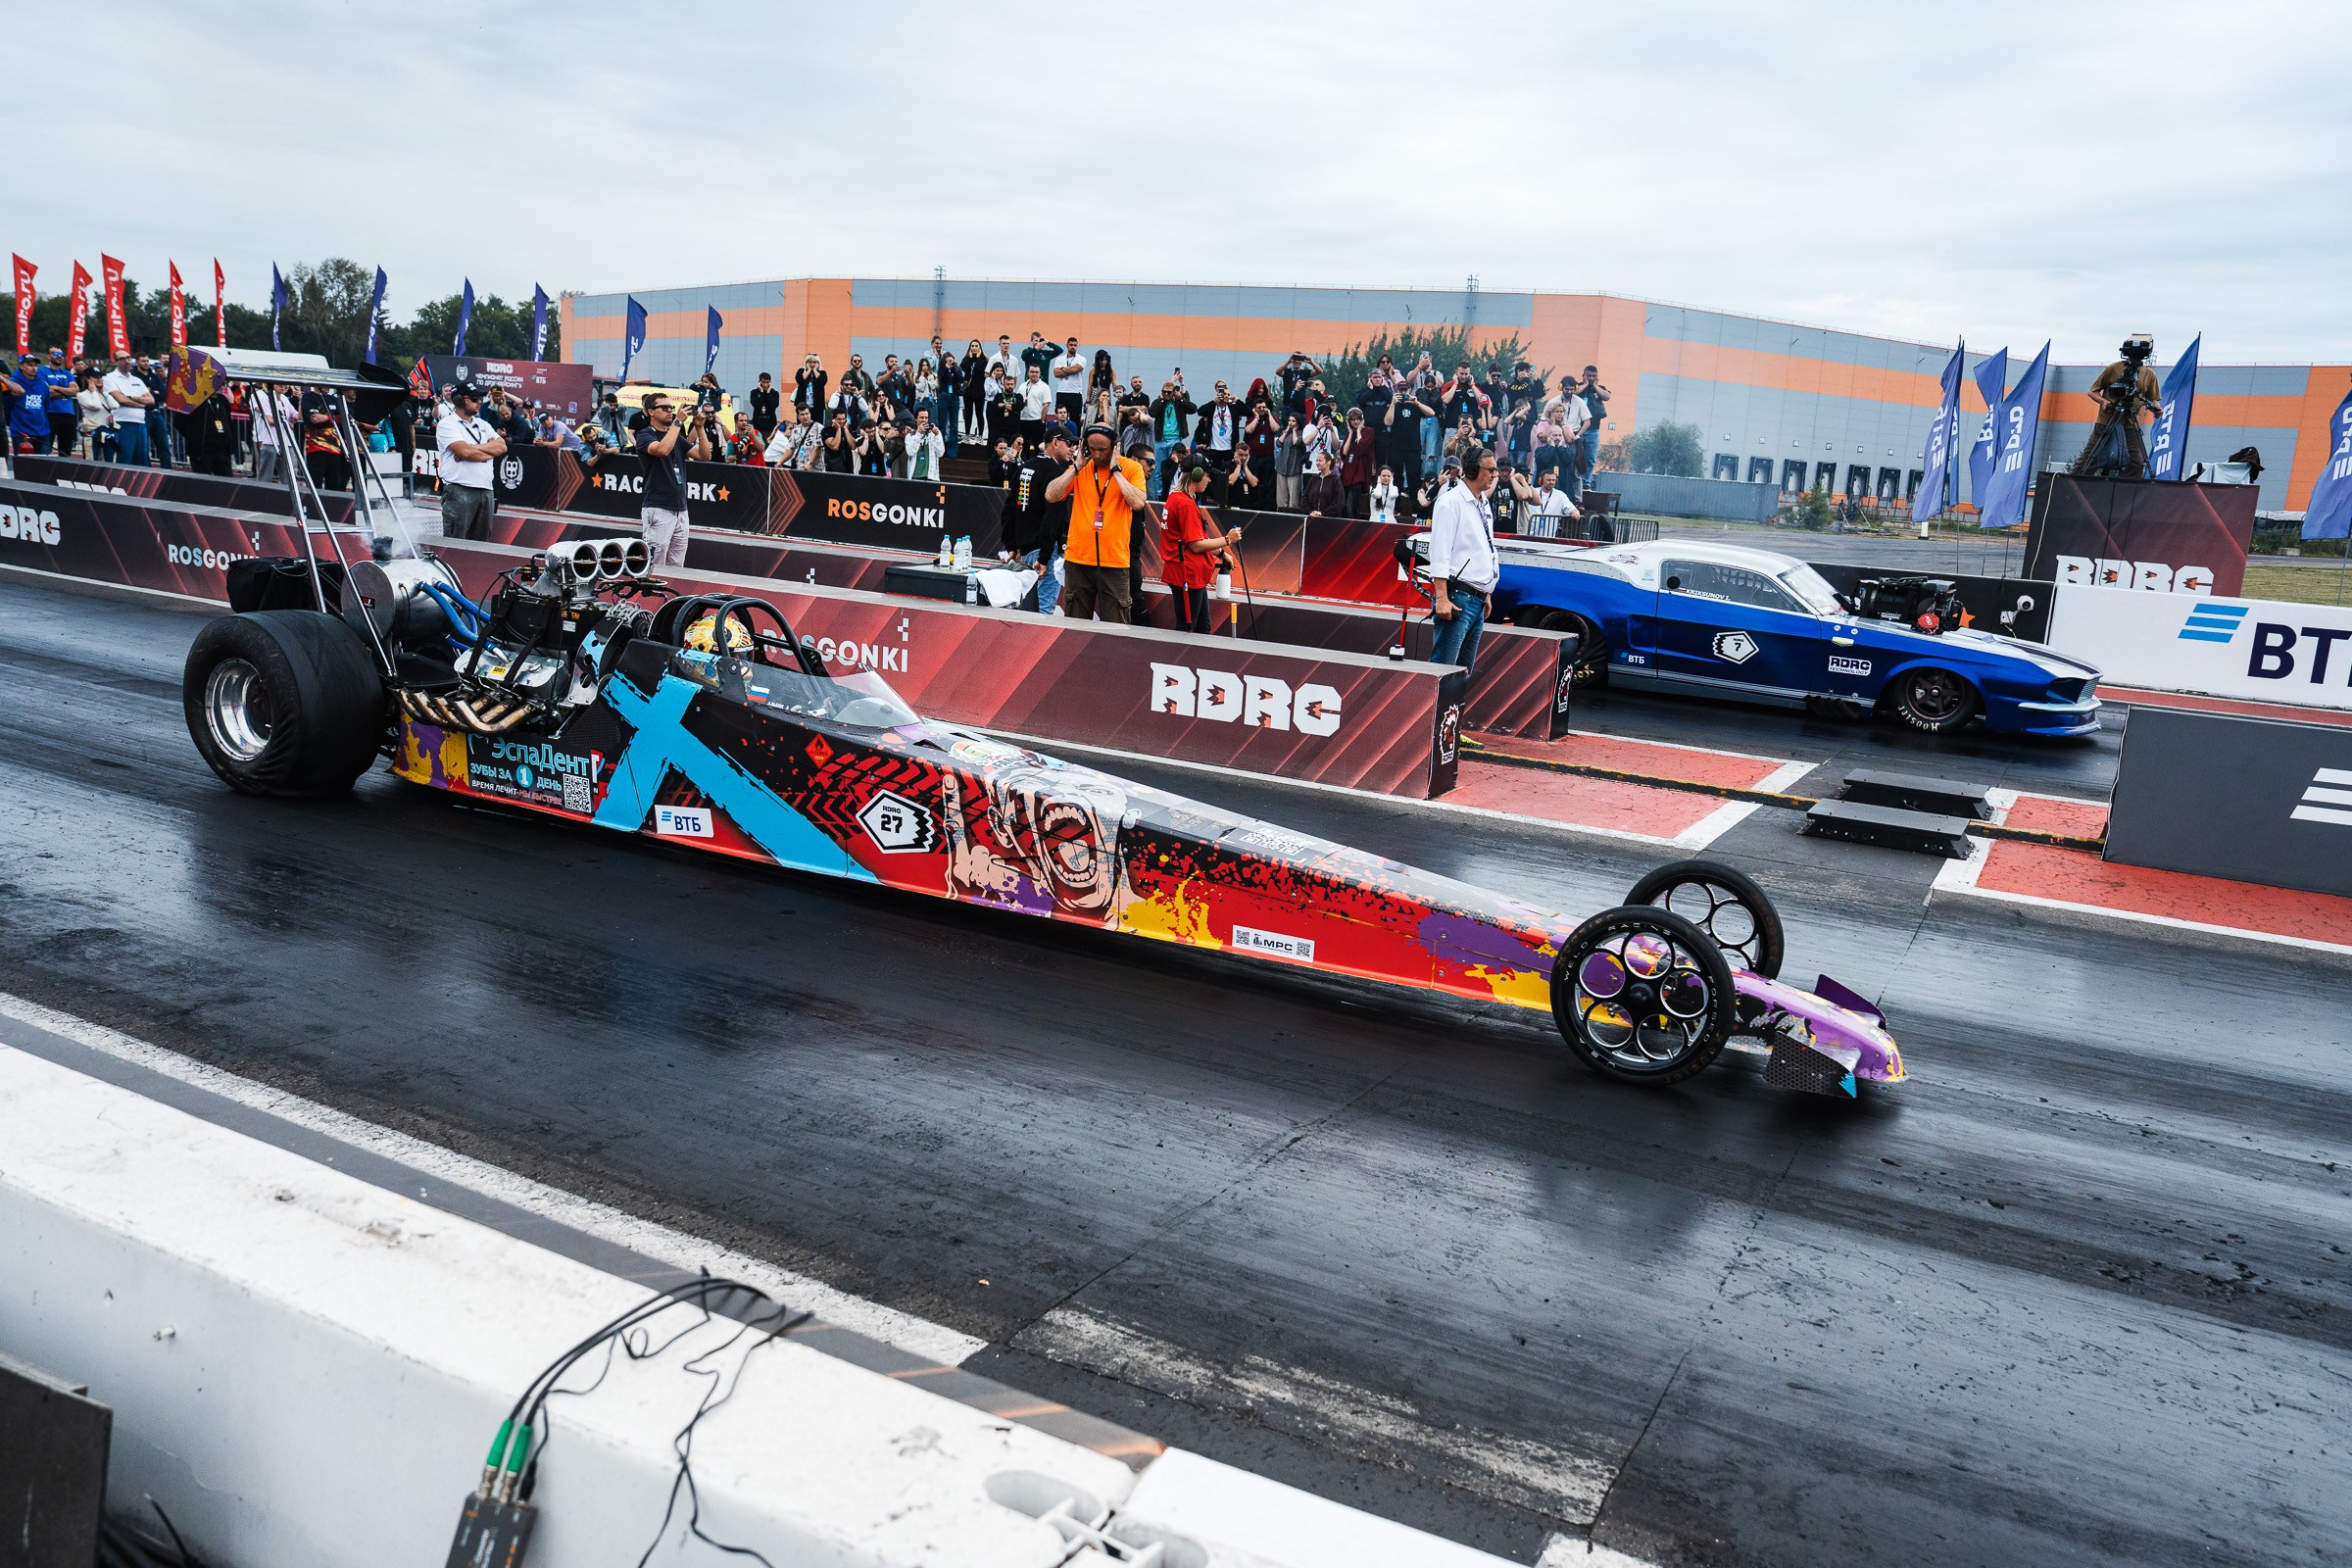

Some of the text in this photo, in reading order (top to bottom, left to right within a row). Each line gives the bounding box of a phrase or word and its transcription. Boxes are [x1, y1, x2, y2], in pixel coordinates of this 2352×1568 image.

[605, 474, 716, 502] RACRK
[0, 504, 61, 546] DRC
[827, 498, 946, 528] ROSGONKI
[169, 544, 260, 570] ROSGO
[1628, 655, 1645, 664] ВТБ
[1735, 642, 1741, 652] 7
[2247, 622, 2352, 687] ВТ
[1829, 666, 1870, 676] TECHNOLOGY
[1830, 657, 1871, 671] RDRC
[1150, 662, 1343, 737] RDRC
[491, 736, 590, 776] ЭспаДент
[470, 762, 563, 792] ЗУБЫ ЗА 1 ДЕНЬ
[471, 780, 495, 791] ВРЕМЯ
[674, 815, 702, 832] ВТБ
[881, 814, 903, 834] 27
[1564, 941, 1589, 980] WELD
